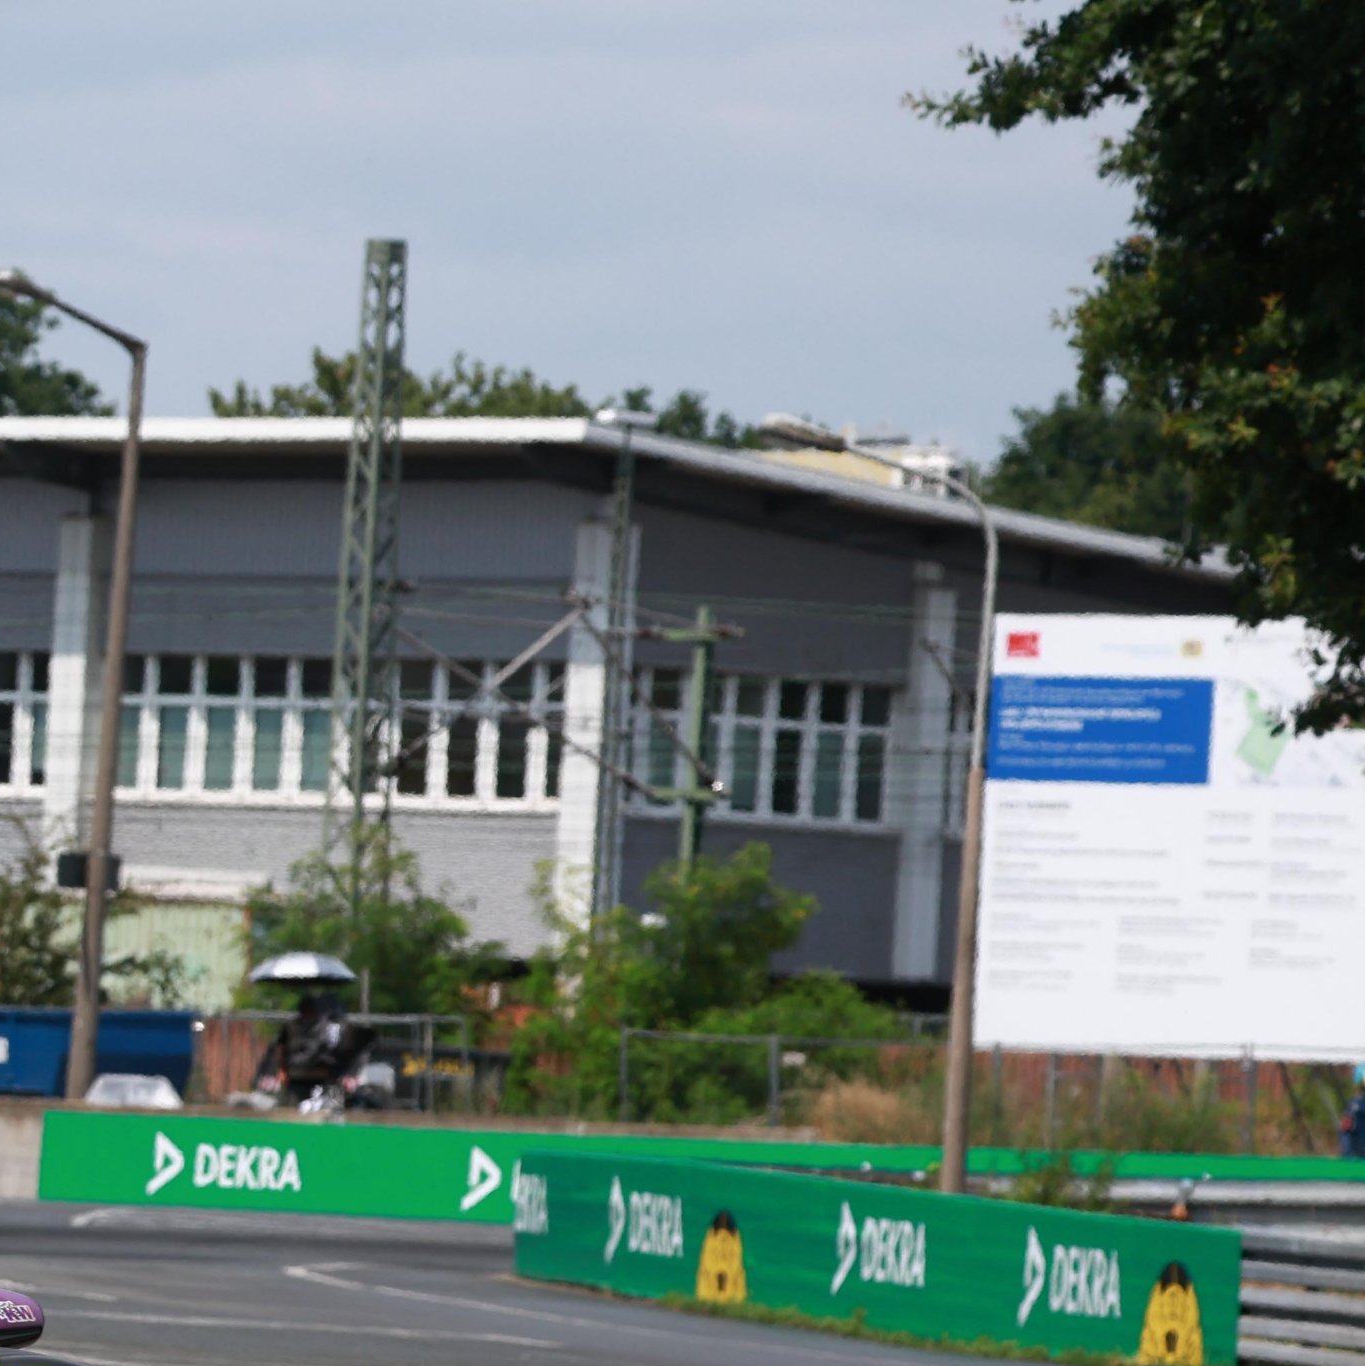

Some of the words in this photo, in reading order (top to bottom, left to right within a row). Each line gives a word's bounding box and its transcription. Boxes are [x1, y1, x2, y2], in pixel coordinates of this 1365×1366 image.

[193, 1142, 301, 1192] DEKRA
[628, 1191, 684, 1259] DEKRA
[860, 1215, 927, 1287] DEKRA
[1049, 1244, 1121, 1319] DEKRA
